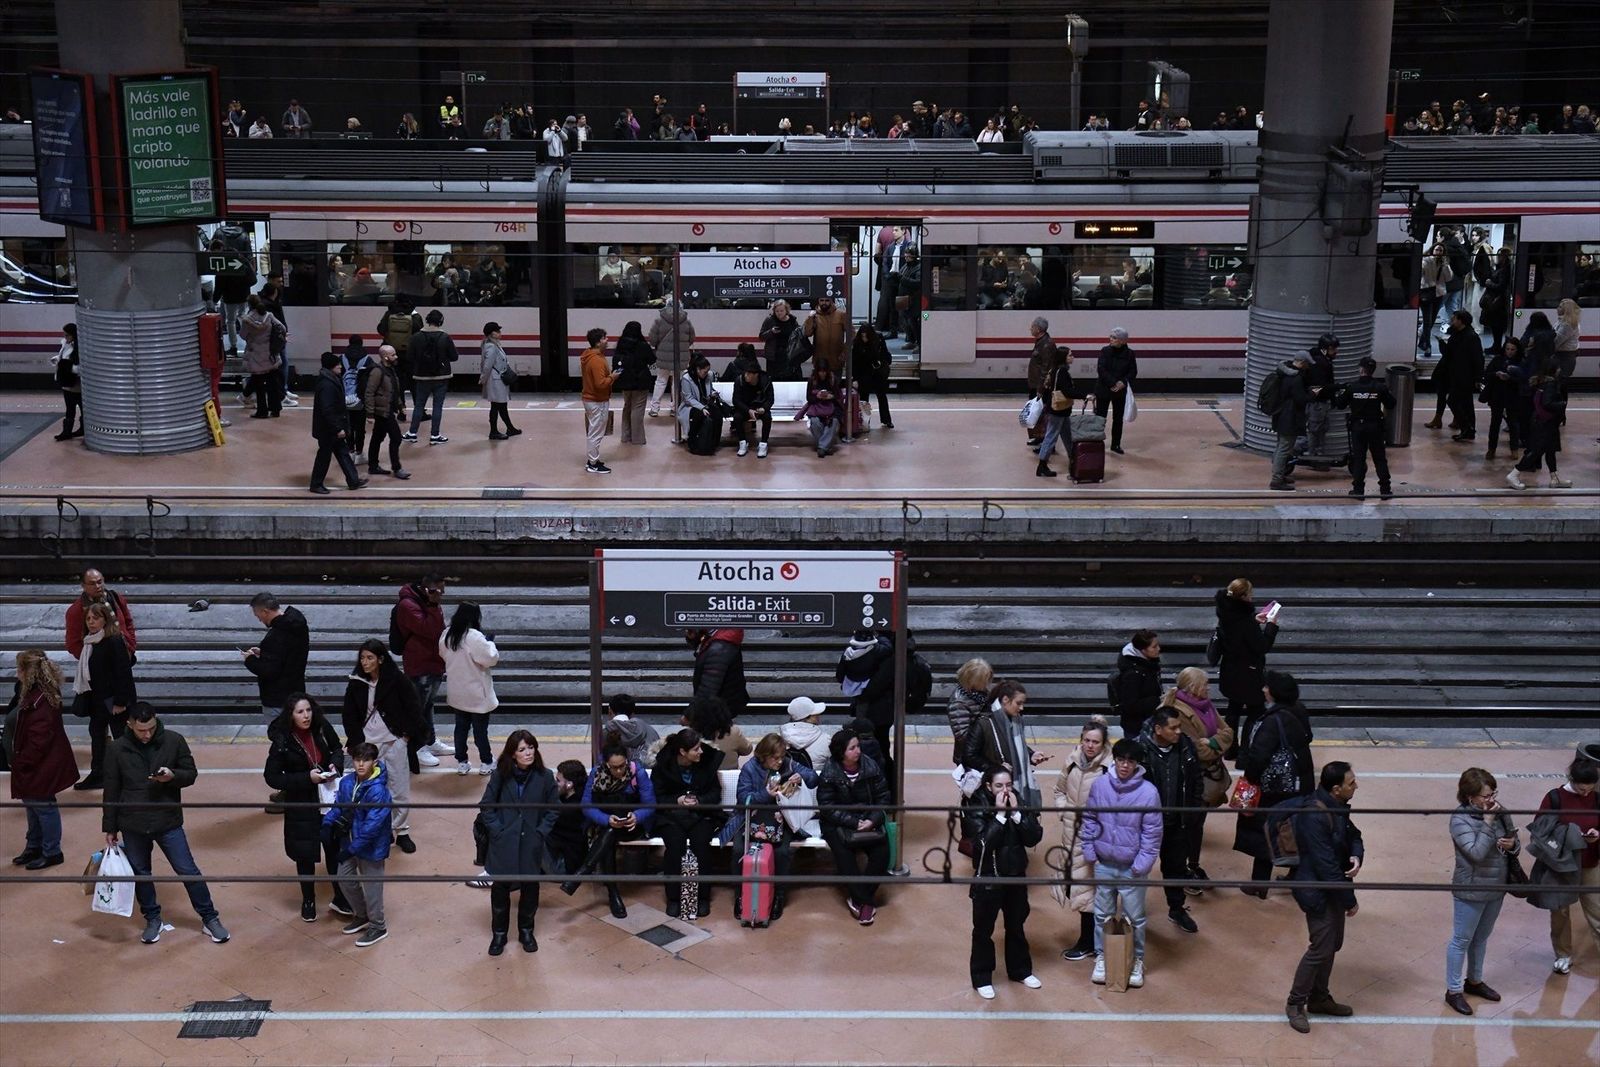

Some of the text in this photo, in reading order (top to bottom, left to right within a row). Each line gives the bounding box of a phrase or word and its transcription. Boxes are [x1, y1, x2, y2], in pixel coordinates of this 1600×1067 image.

[766, 76, 790, 84] Atocha
[130, 88, 190, 104] Más vale
[131, 106, 197, 121] ladrillo en
[132, 122, 200, 137] mano que
[133, 140, 173, 155] cripto
[135, 154, 190, 170] volando
[137, 192, 188, 204] que construyen
[734, 257, 777, 270] Atocha
[738, 279, 786, 288] Salida Exit
[698, 560, 774, 581] Atocha
[708, 596, 790, 611] Salida Exit
[767, 614, 778, 622] T4
